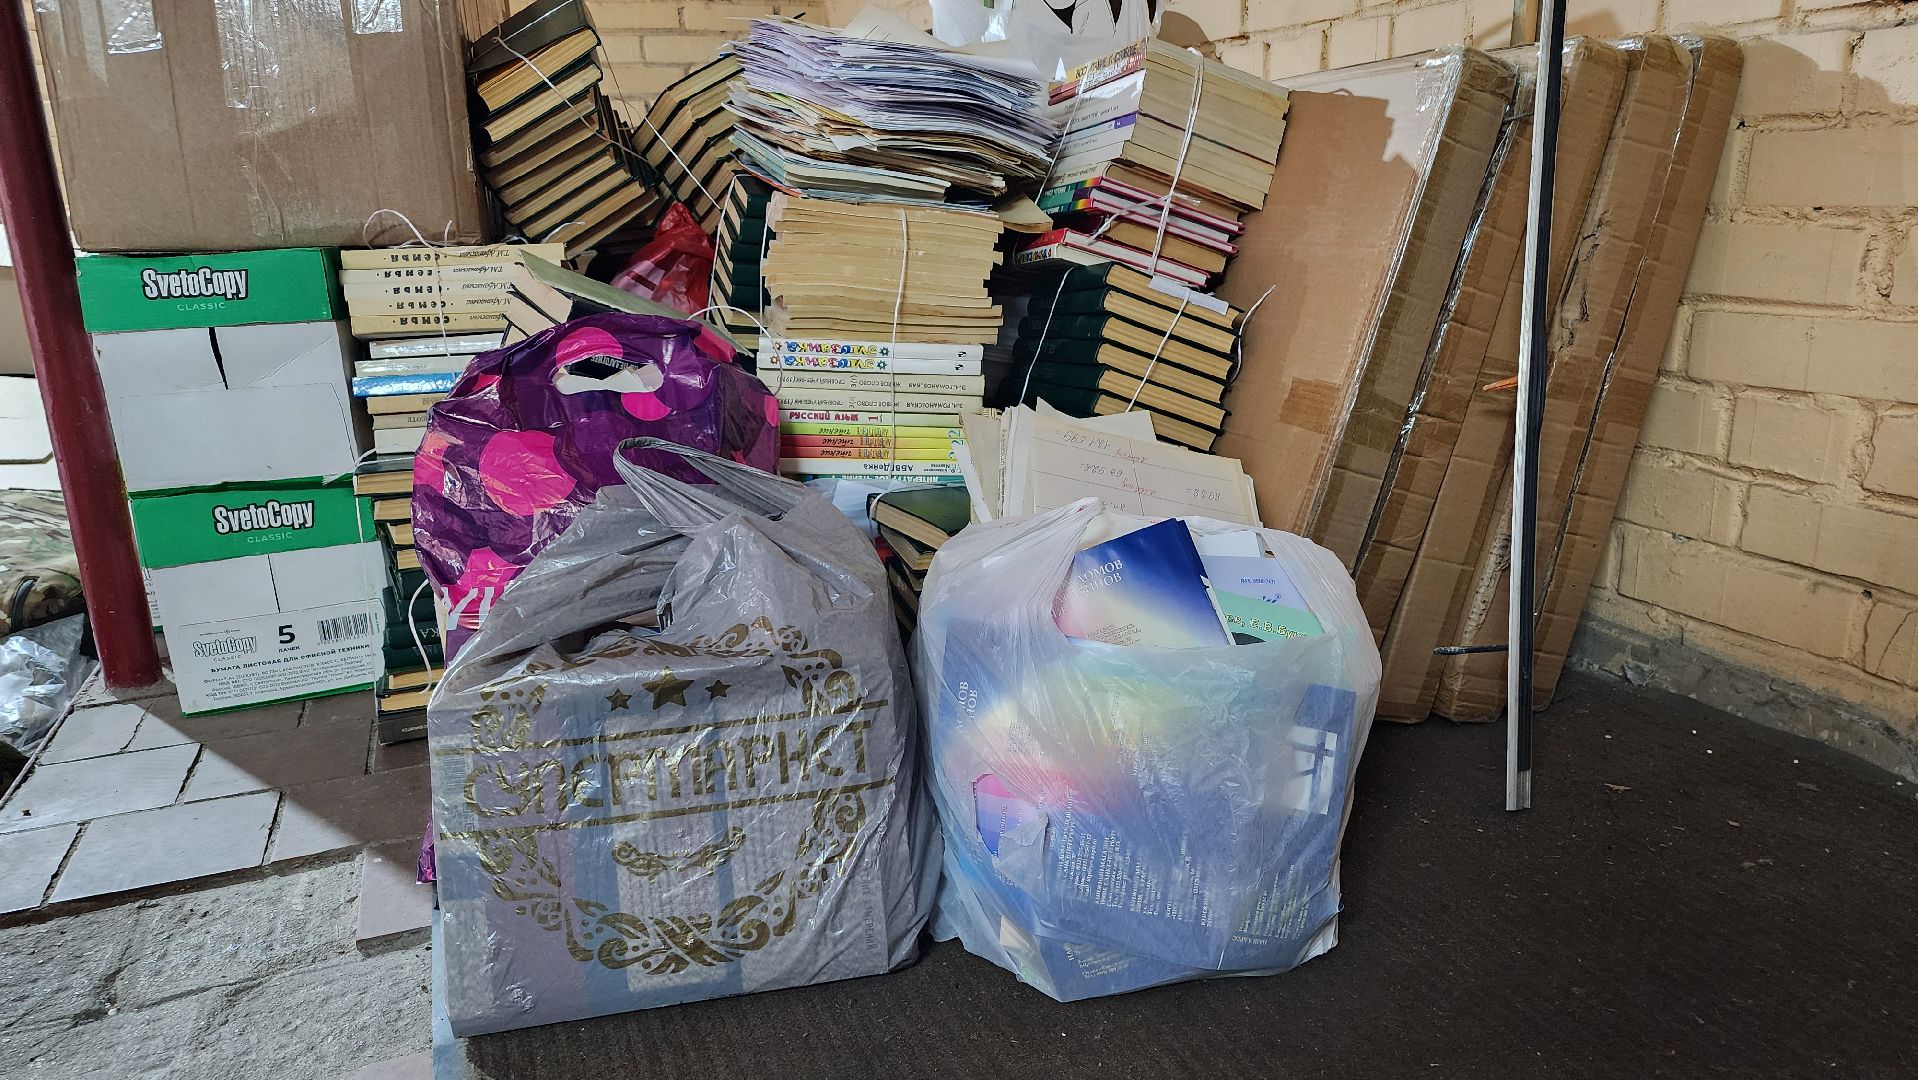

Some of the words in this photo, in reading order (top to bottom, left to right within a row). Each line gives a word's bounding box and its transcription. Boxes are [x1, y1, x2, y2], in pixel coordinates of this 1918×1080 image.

[142, 267, 248, 299] SvetoCopy
[177, 302, 226, 312] CLASSIC
[789, 410, 830, 420] РУССКИЙ
[835, 412, 859, 421] ЯЗЫК
[212, 500, 314, 535] SvetoCopy
[247, 531, 293, 544] CLASSIC
[278, 624, 296, 644] 5
[193, 635, 257, 658] SvetoCopy
[278, 645, 301, 653] ПАЧЕК
[210, 664, 241, 673] БУМАГА
[243, 659, 281, 669] ЛИСТОВАЯ
[283, 656, 299, 664] ДЛЯ
[301, 648, 337, 660] ОФИСНОЙ
[338, 644, 370, 653] ТЕХНИКИ
[463, 719, 873, 818] СУПЕРМАРКЕТ
